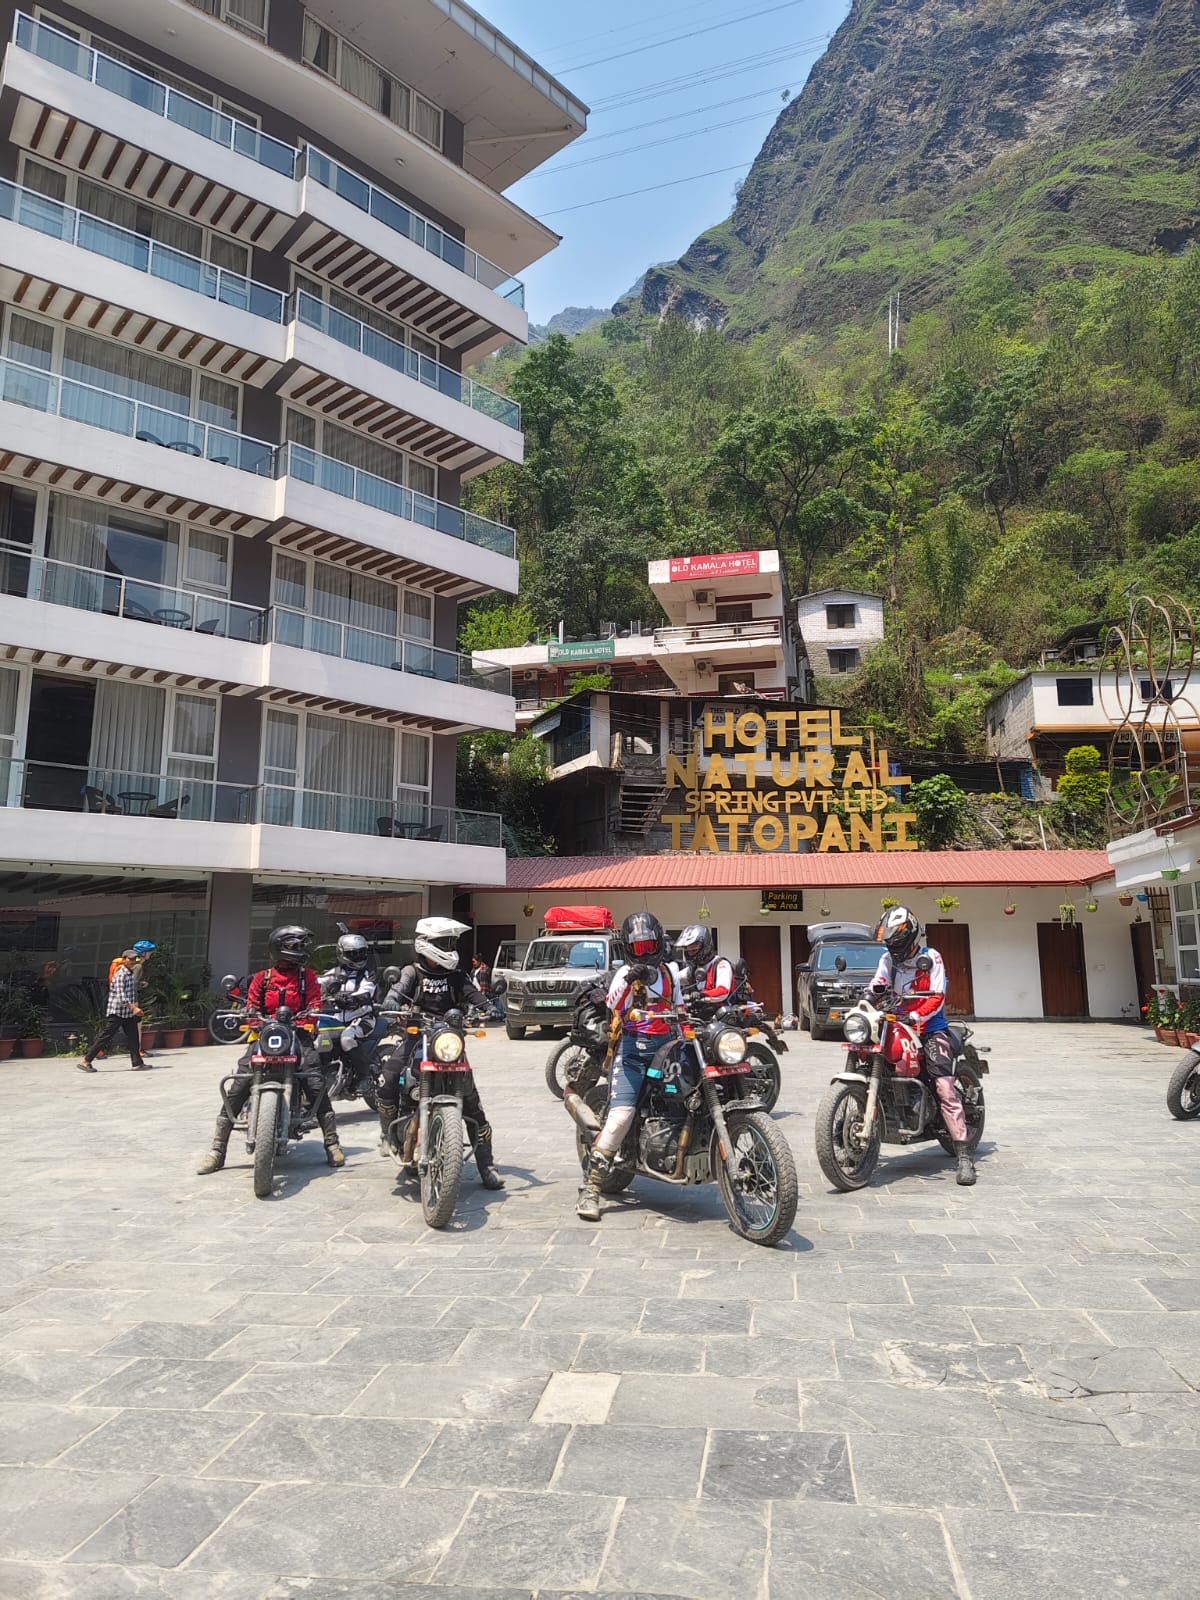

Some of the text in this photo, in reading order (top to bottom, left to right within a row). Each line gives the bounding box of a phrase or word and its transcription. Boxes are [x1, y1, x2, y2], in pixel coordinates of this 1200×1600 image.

[691, 560, 727, 571] KAMALA
[728, 558, 757, 568] HOTEL
[558, 646, 612, 656] OLD KAMALA HOTEL
[703, 709, 863, 748] HOTEL
[665, 749, 912, 789] NATURAL
[686, 790, 780, 814] SPRING
[661, 812, 919, 852] TATOPANI
[768, 891, 798, 902] Parking
[780, 901, 798, 910] Area
